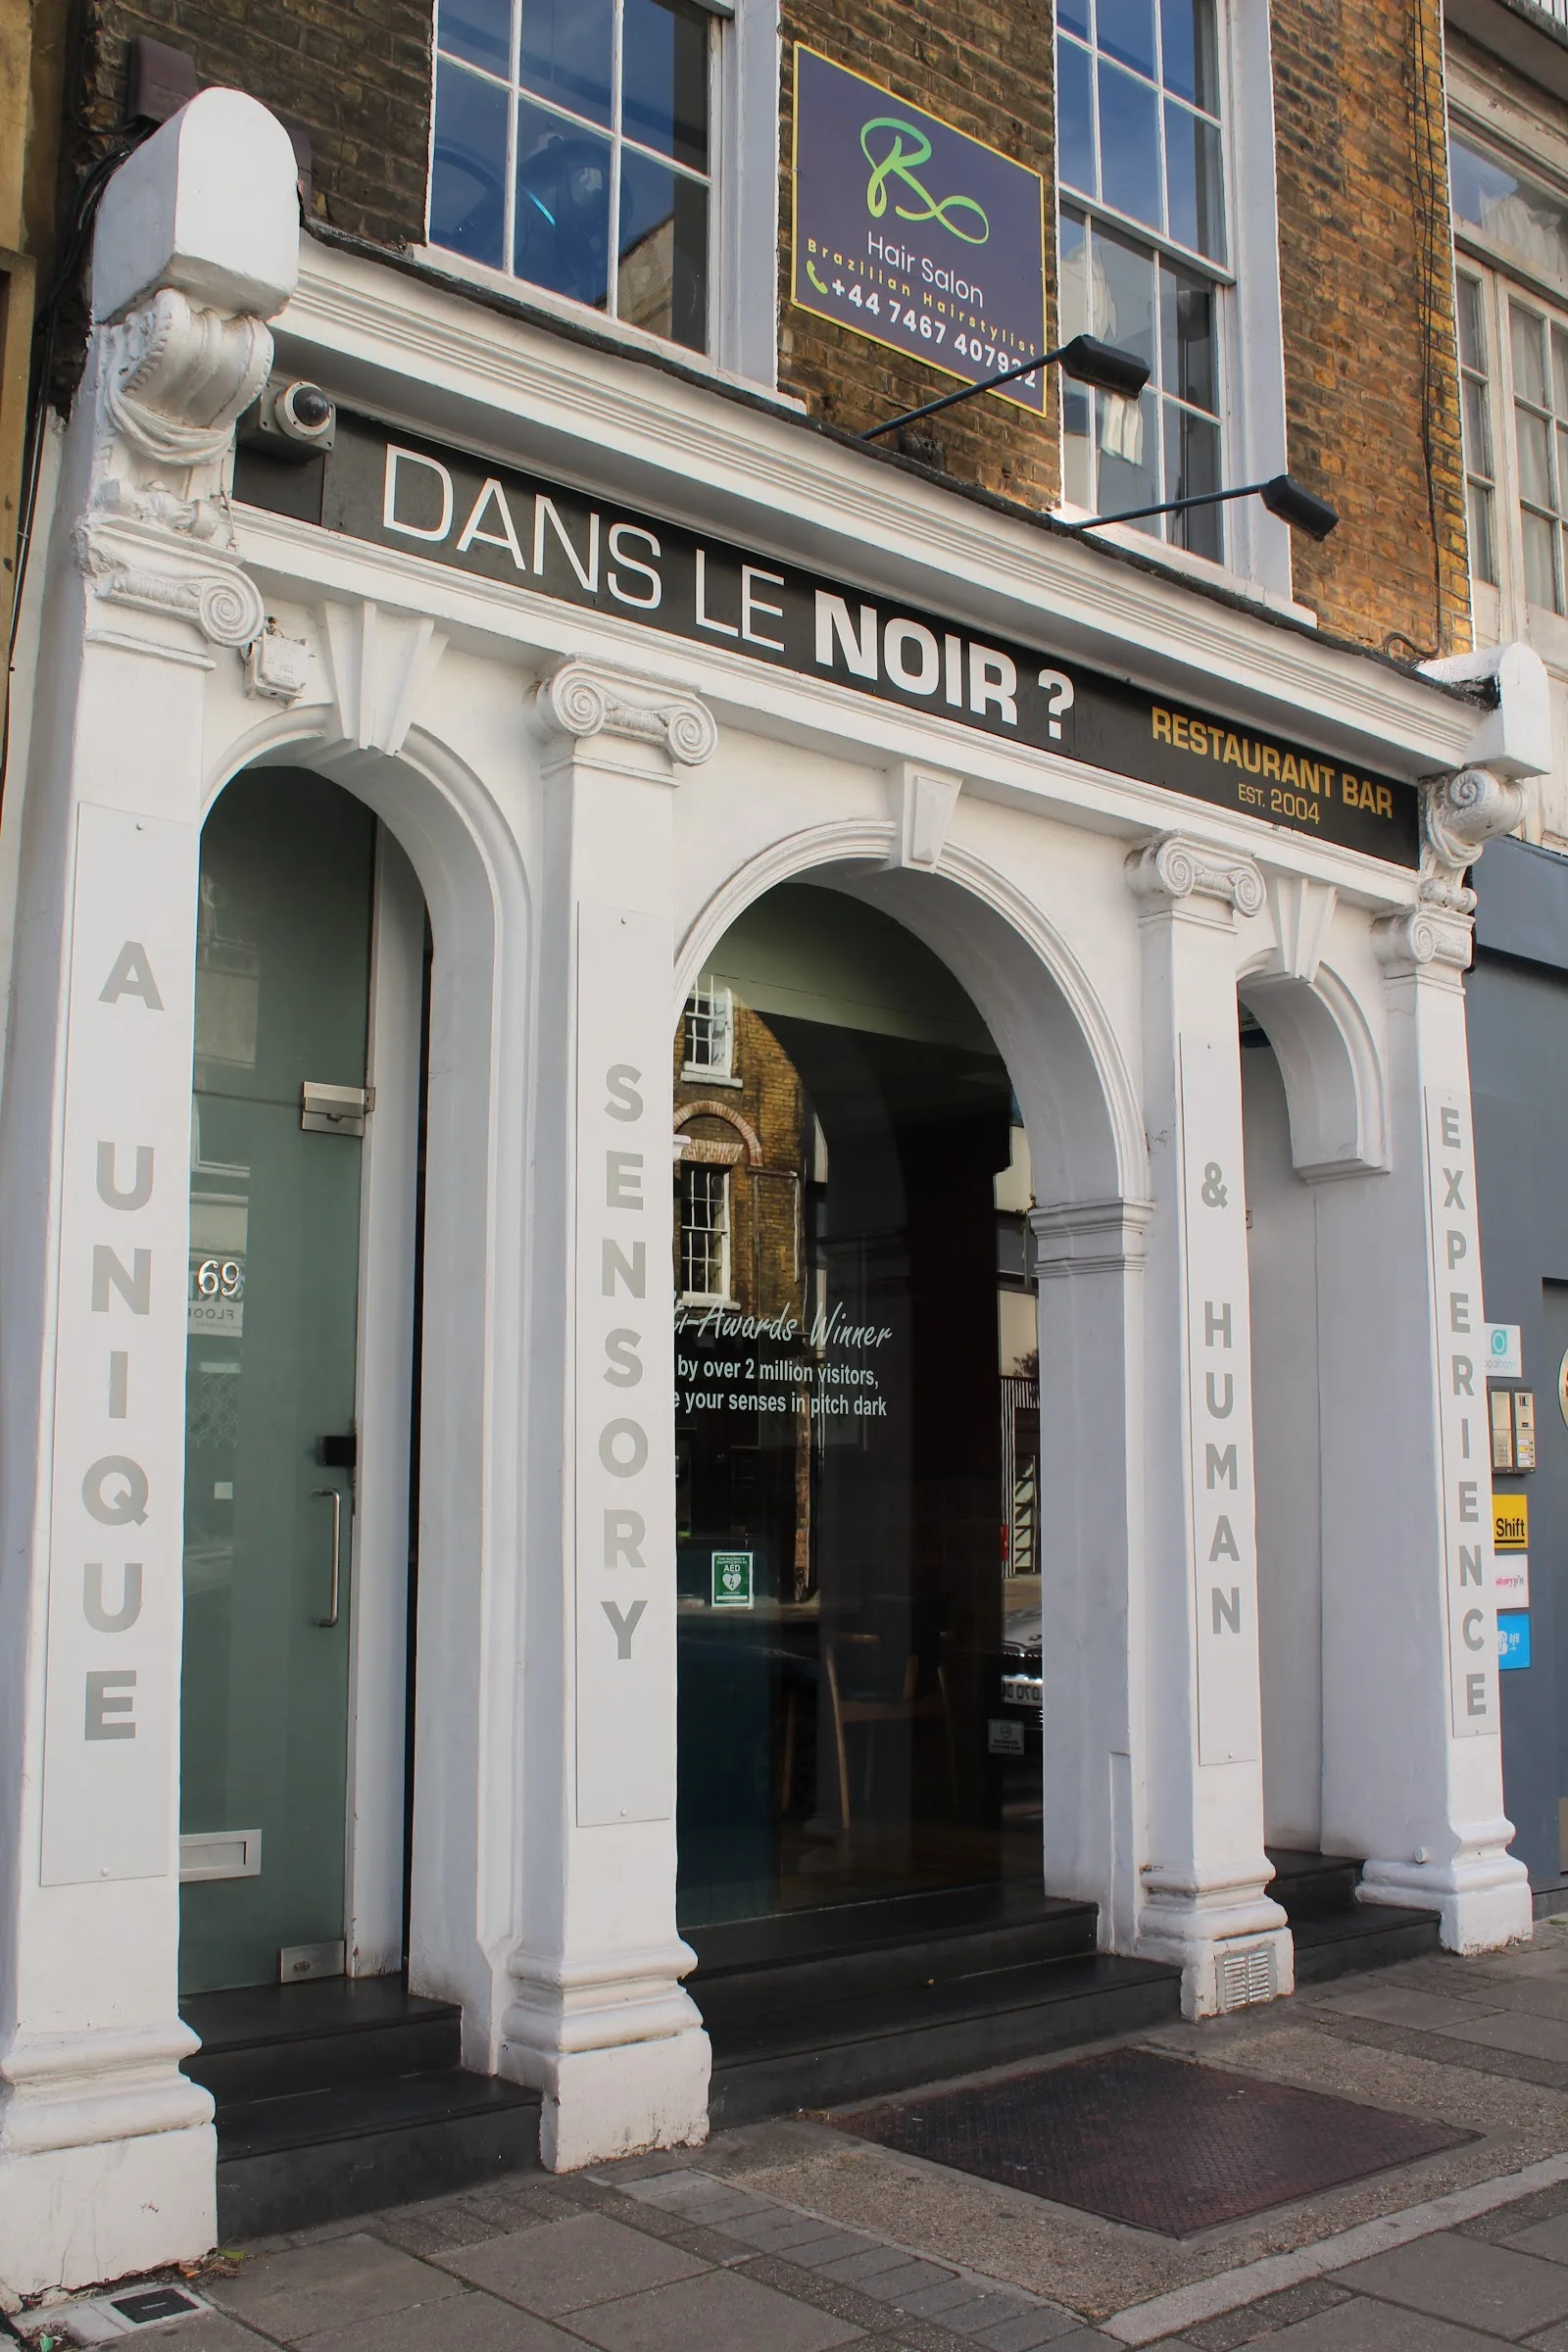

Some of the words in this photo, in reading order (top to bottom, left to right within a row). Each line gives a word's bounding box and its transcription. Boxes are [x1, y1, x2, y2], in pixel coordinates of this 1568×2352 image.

[807, 237, 910, 297] Brazilian
[922, 291, 1035, 358] Hairstylist
[867, 230, 915, 273] Hair
[920, 257, 984, 309] Salon
[832, 278, 881, 316] +44
[888, 299, 947, 344] 7467
[383, 442, 662, 610] DANS
[695, 549, 785, 652] LE
[814, 589, 1018, 726] NOIR
[1038, 668, 1075, 740] ?
[1152, 706, 1336, 799] RESTAURANT
[1342, 772, 1393, 819] BAR
[1238, 783, 1265, 808] EST.
[1270, 788, 1321, 825] 2004
[98, 941, 165, 1012] A
[1200, 1161, 1228, 1209] &
[197, 1259, 241, 1297] 69
[809, 1301, 893, 1348] Winner
[598, 1063, 649, 1661] SENSORY
[677, 1354, 699, 1382] by
[704, 1360, 742, 1379] over
[745, 1358, 755, 1380] 2
[760, 1358, 813, 1383] million
[817, 1362, 879, 1390] visitors,
[81, 1141, 155, 1741] UNIQUE
[685, 1392, 724, 1414] your
[728, 1393, 787, 1412] senses
[791, 1392, 806, 1413] in
[810, 1393, 849, 1419] pitch
[854, 1395, 888, 1417] dark
[1440, 1106, 1487, 1716] EXPERIENCE
[1203, 1300, 1242, 1636] HUMAN
[1495, 1517, 1525, 1538] Shift
